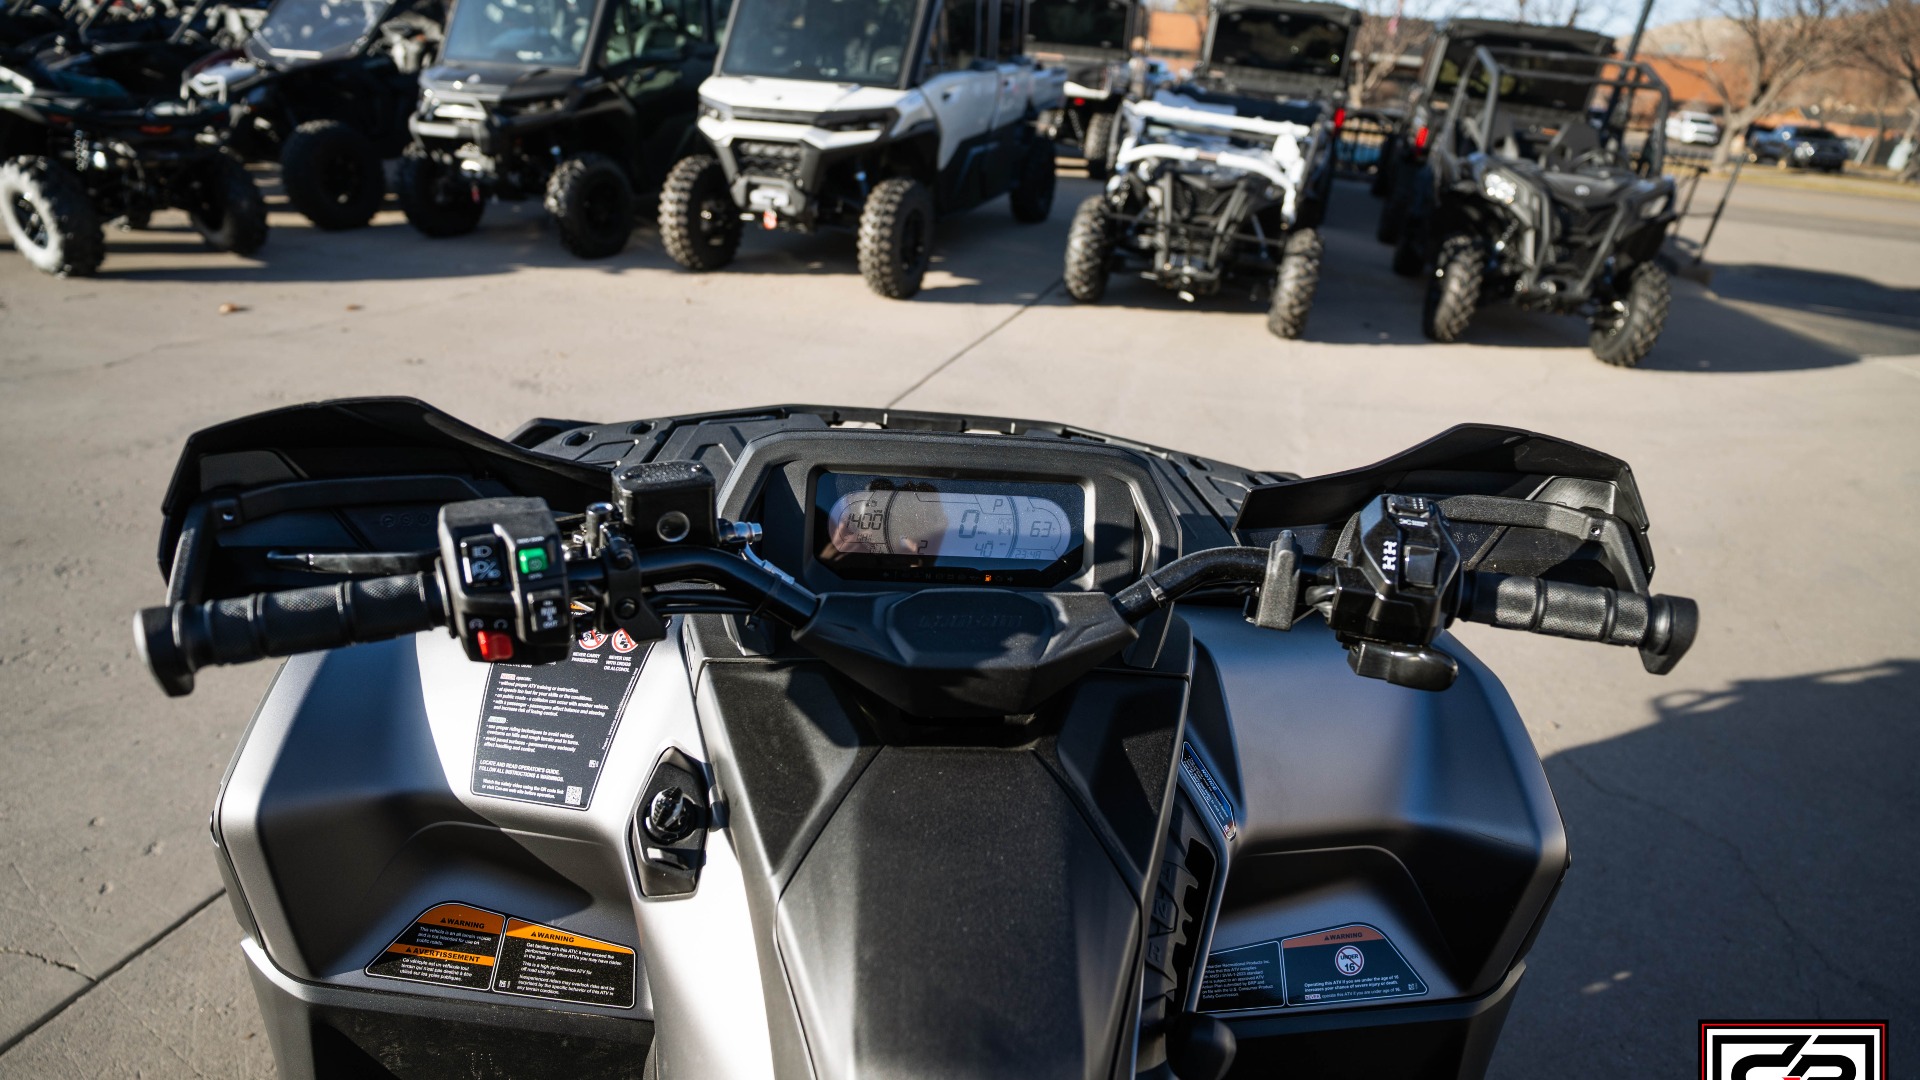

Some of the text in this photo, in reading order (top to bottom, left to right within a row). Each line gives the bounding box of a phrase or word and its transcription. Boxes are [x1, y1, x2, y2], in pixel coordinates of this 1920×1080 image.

[992, 499, 1003, 512] P
[846, 512, 883, 530] 1400
[958, 510, 980, 538] 0
[1030, 521, 1051, 538] 63
[448, 919, 484, 929] WARNING
[538, 932, 574, 942] WARNING
[1329, 932, 1363, 941] WARNING
[414, 946, 480, 962] AVERTISSEMENT
[1344, 963, 1355, 971] 16
